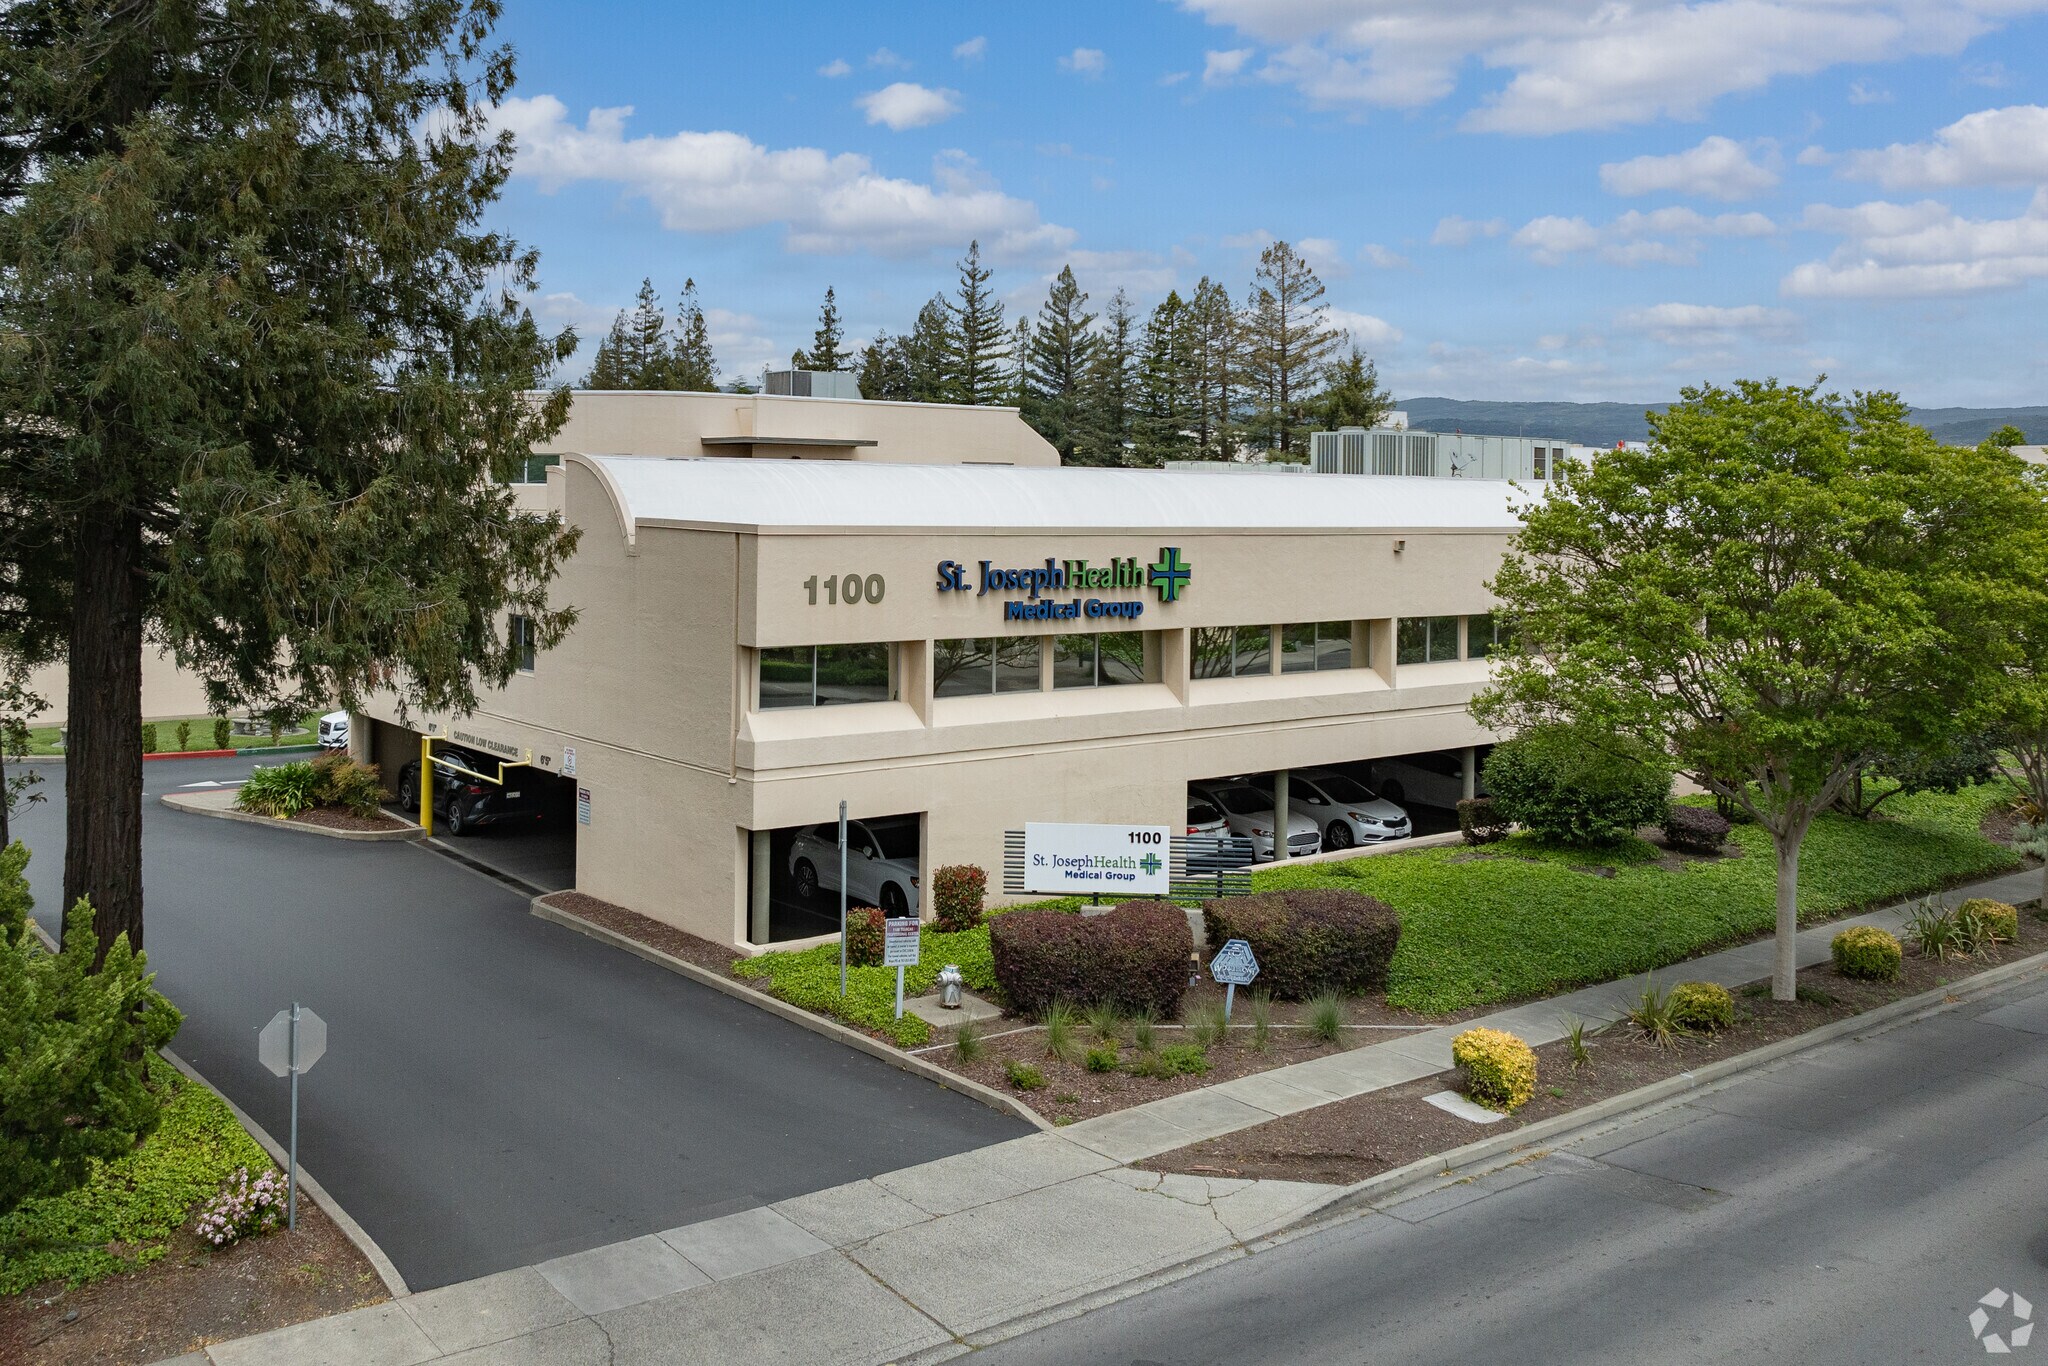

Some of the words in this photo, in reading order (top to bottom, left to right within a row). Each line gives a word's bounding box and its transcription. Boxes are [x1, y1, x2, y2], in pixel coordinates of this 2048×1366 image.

[936, 560, 972, 592] St.
[803, 573, 886, 605] 1100
[1004, 599, 1081, 622] Medical
[1083, 597, 1144, 619] Group
[453, 730, 475, 745] CAUTION
[475, 736, 487, 748] LOW
[487, 740, 519, 757] CLEARANCE
[1128, 831, 1162, 845] 1100
[1032, 853, 1049, 867] St.
[1064, 870, 1103, 880] Medical
[1105, 871, 1136, 882] Group
